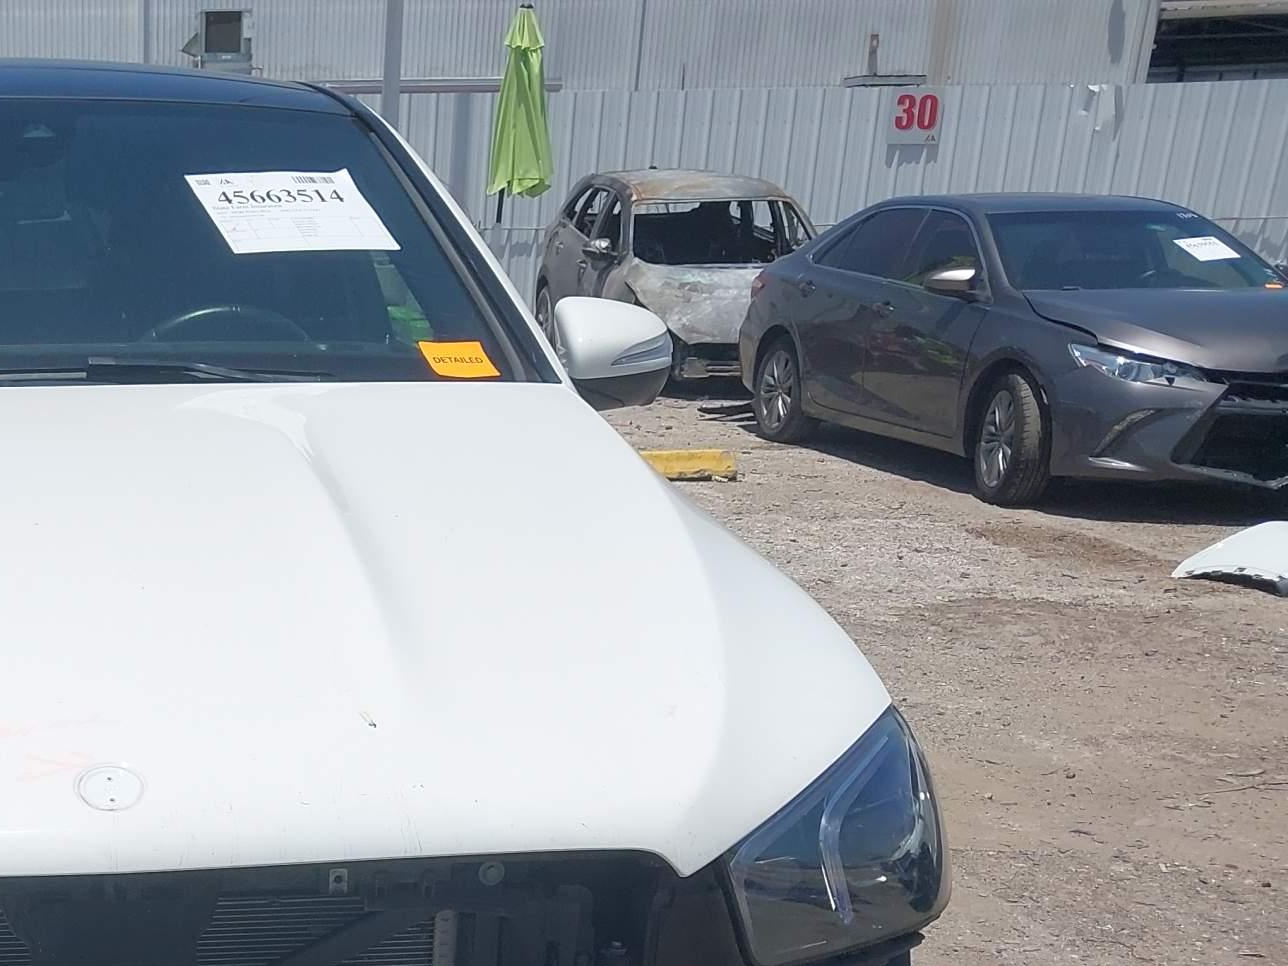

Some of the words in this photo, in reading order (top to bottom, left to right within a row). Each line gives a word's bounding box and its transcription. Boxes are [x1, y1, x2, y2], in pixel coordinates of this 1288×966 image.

[894, 94, 939, 130] 30
[217, 188, 345, 204] 45663514
[432, 356, 484, 364] DETAILED
